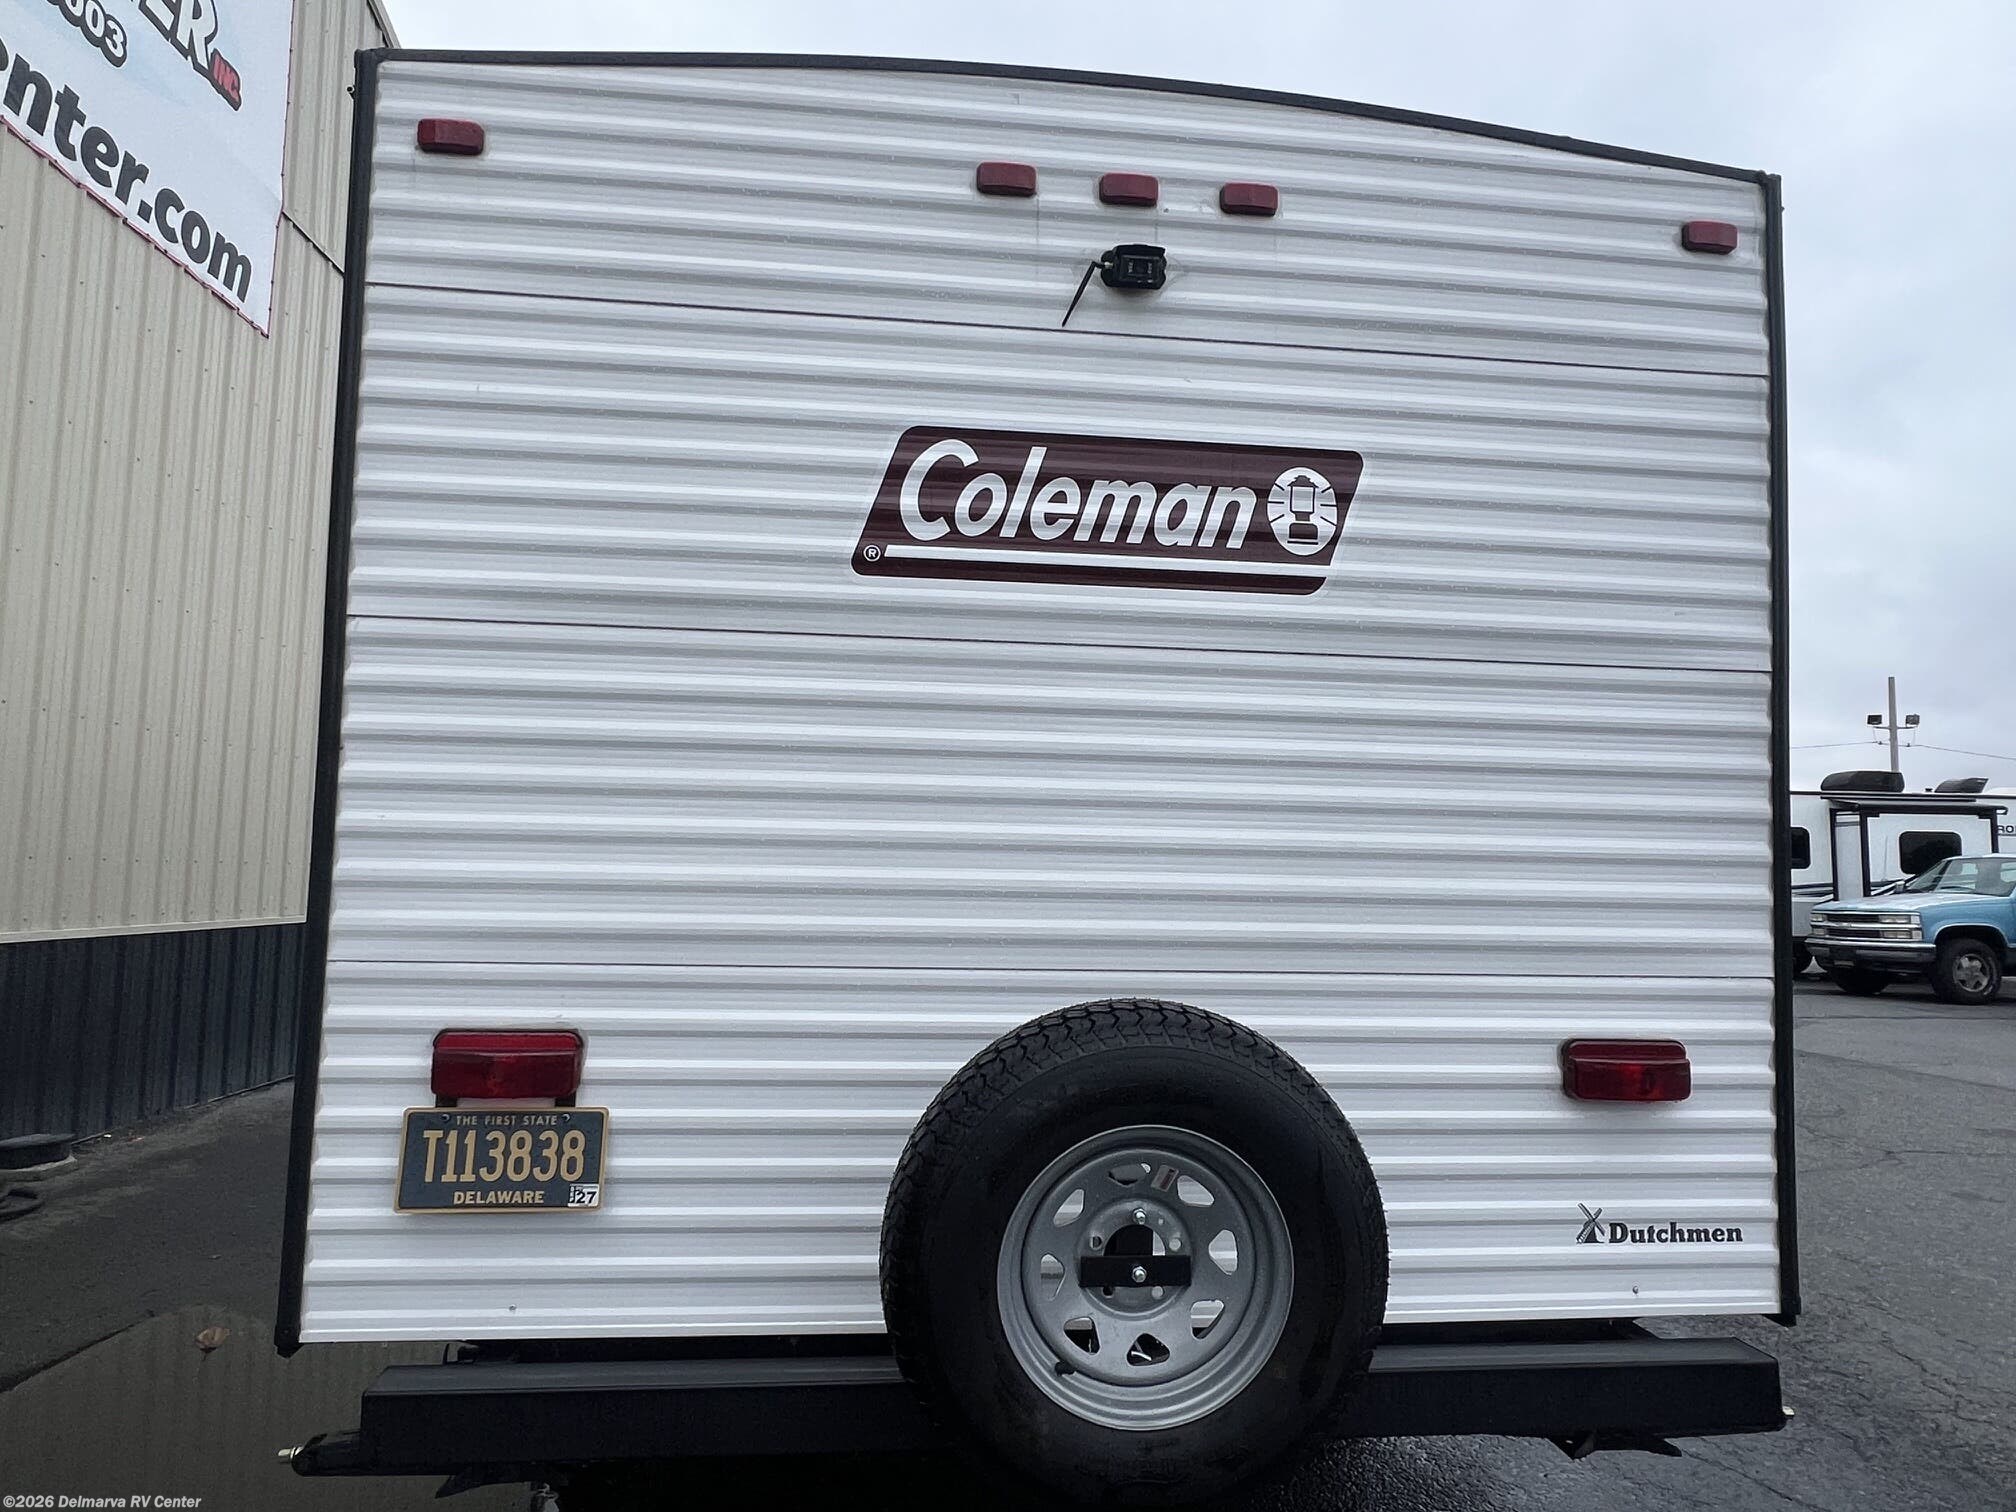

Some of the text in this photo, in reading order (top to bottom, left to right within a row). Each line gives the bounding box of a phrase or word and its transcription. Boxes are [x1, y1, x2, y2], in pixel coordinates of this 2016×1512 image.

[0, 37, 251, 303] nter.com
[900, 438, 1258, 549] Coleman
[456, 1115, 558, 1125] THE FIRST STATE
[422, 1129, 586, 1183] T113838
[453, 1190, 544, 1205] DELAWARE
[576, 1191, 598, 1204] 27
[1608, 1222, 1743, 1244] Dutchmen
